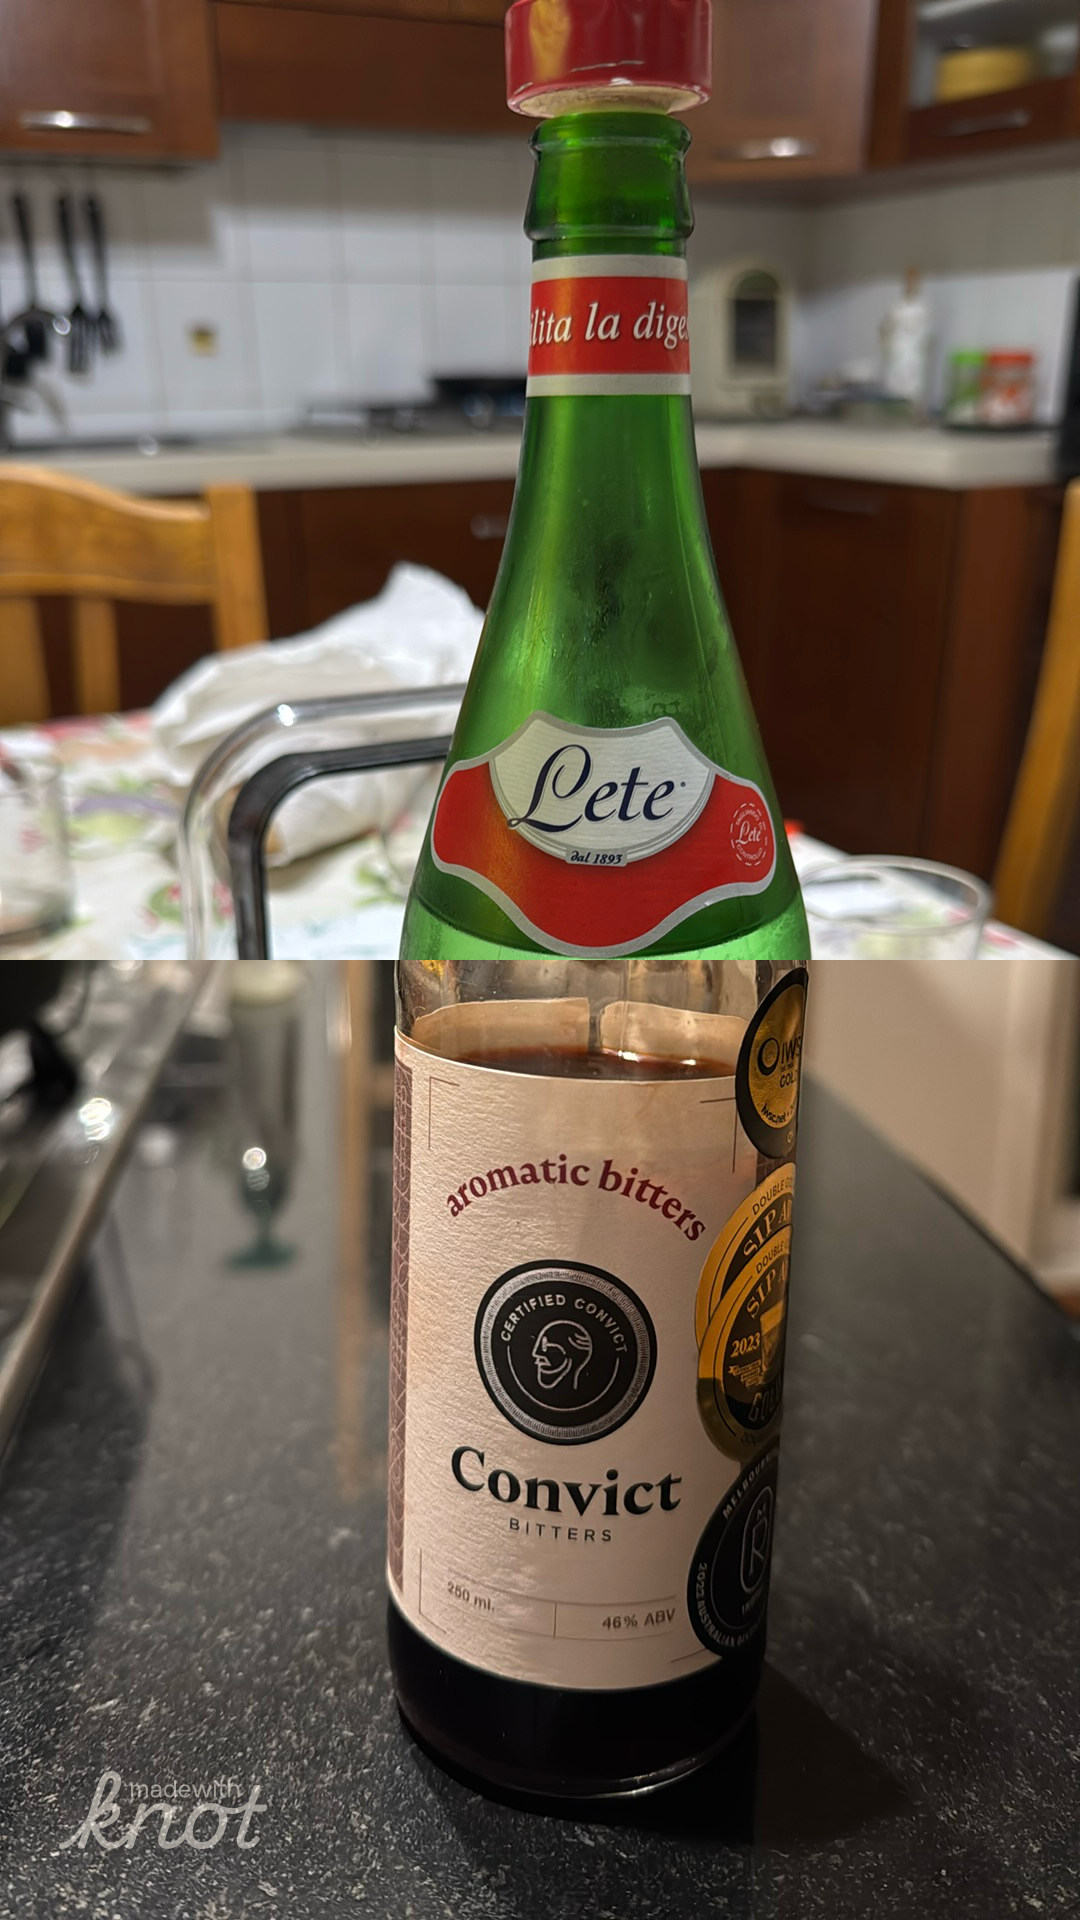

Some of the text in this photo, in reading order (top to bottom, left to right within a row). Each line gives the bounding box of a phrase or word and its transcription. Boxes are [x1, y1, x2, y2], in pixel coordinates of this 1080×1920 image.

[585, 301, 620, 341] la
[633, 301, 689, 349] dige
[507, 744, 675, 832] Lete
[570, 851, 623, 865] dal 1893
[446, 1154, 706, 1241] aromatic bitters
[752, 1181, 784, 1216] DOUBLE
[743, 1208, 777, 1257] SIP
[756, 1243, 784, 1274] DOUBLE
[746, 1268, 776, 1319] SIP
[501, 1294, 627, 1352] CERTIFIED CONVICT
[730, 1332, 760, 1358] 2023
[451, 1446, 682, 1516] Convict
[509, 1518, 612, 1542] BITTERS
[447, 1581, 470, 1602] 250
[602, 1607, 676, 1631] 46% ABV
